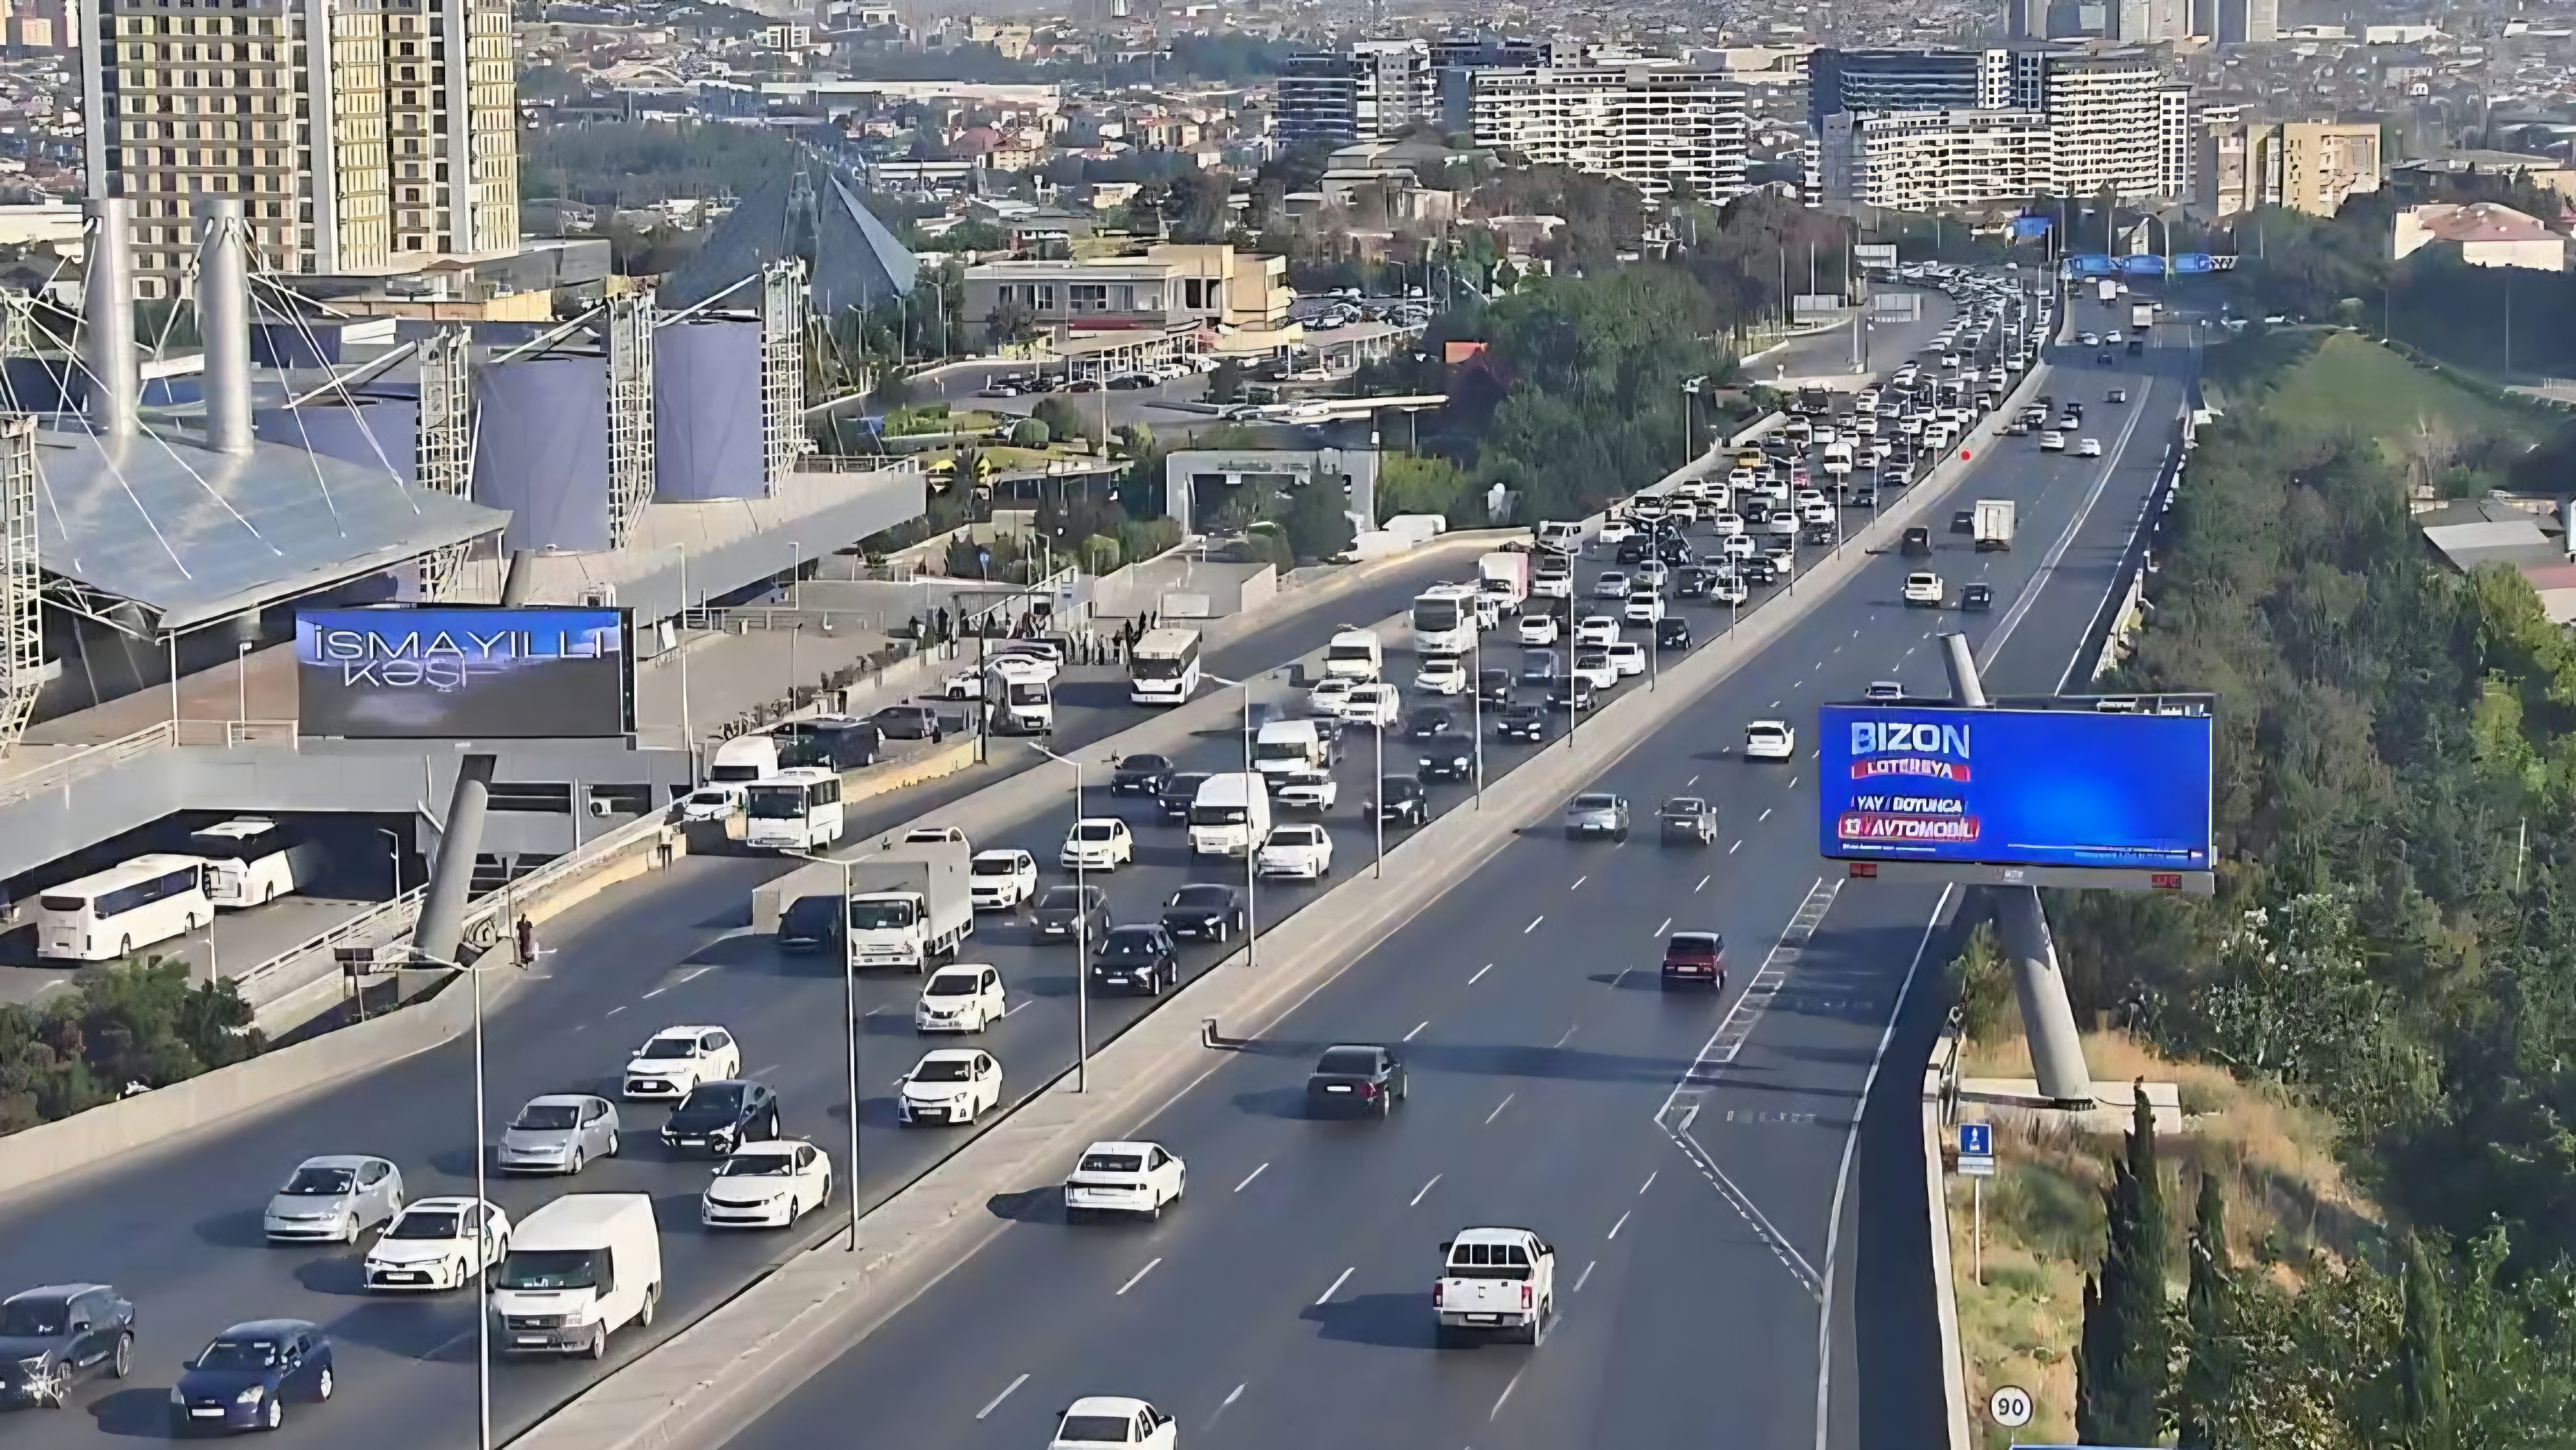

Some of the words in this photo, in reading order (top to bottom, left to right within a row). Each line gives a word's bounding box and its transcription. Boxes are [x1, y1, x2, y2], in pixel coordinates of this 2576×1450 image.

[1851, 722, 1969, 759] BIZON
[1867, 758, 1953, 780] LOTYA
[1998, 1398, 2024, 1416] 90
